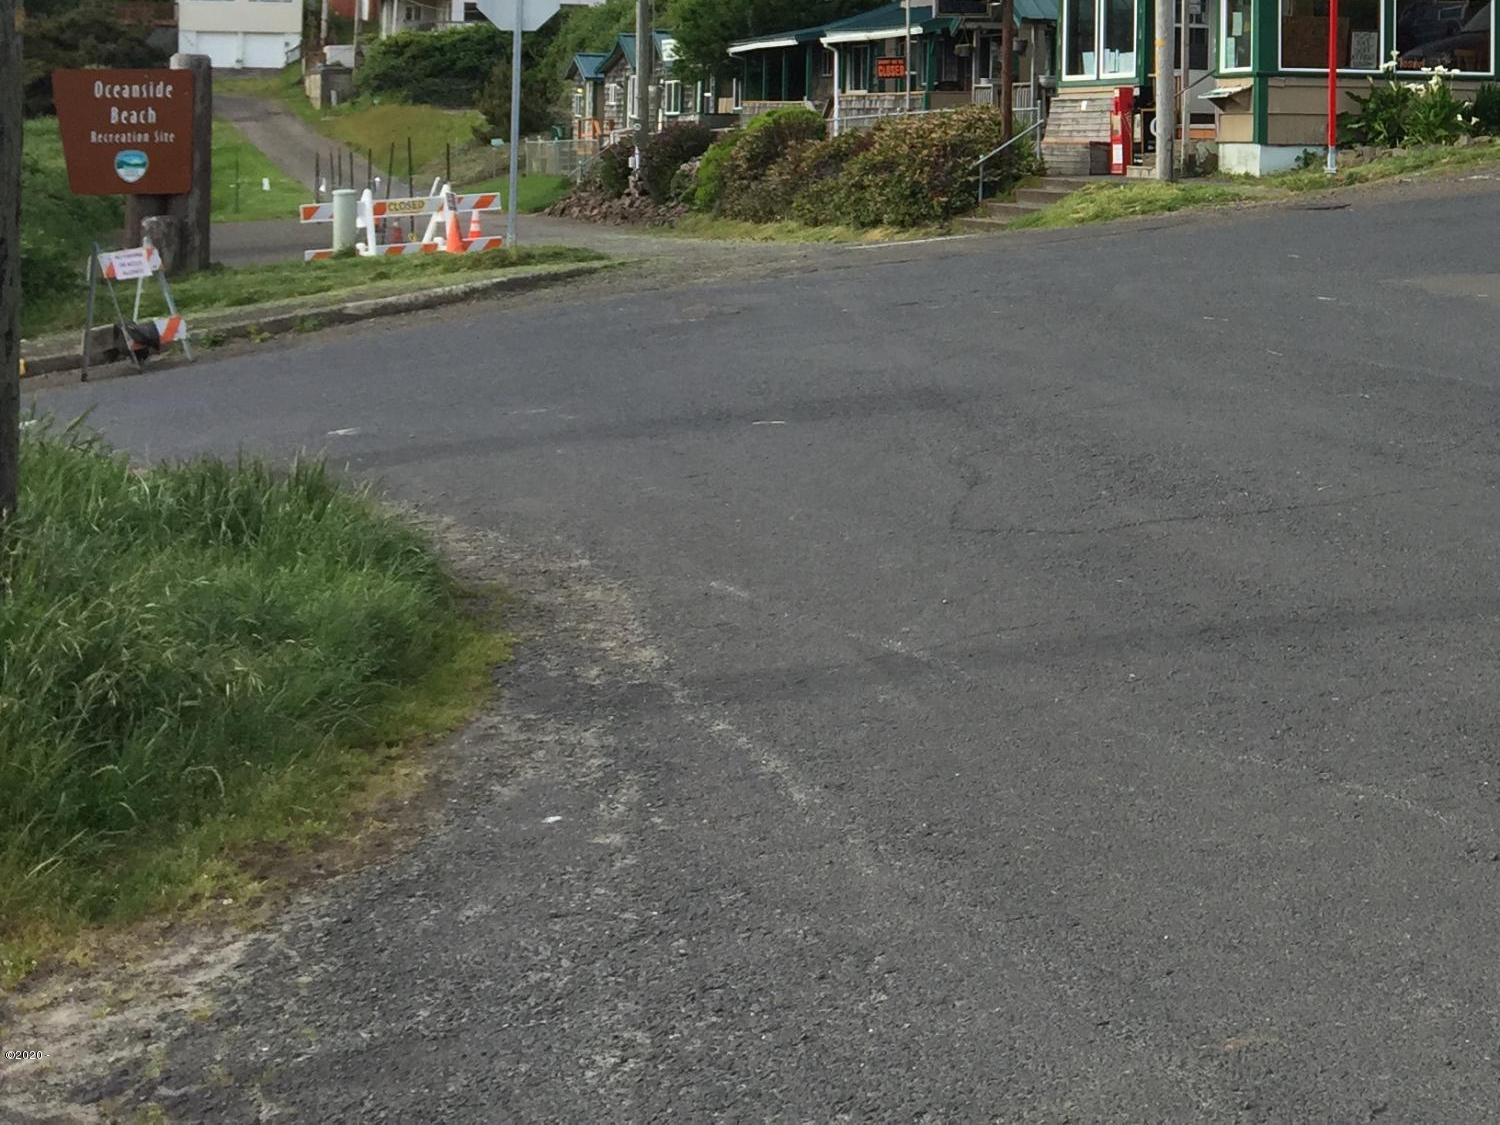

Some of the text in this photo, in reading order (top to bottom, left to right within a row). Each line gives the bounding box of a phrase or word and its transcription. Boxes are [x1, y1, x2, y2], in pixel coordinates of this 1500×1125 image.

[878, 64, 905, 77] CLOSED
[94, 81, 174, 98] Oceanside
[110, 106, 156, 124] Beach
[90, 130, 175, 143] Recreation Site
[388, 200, 425, 211] CLOSED
